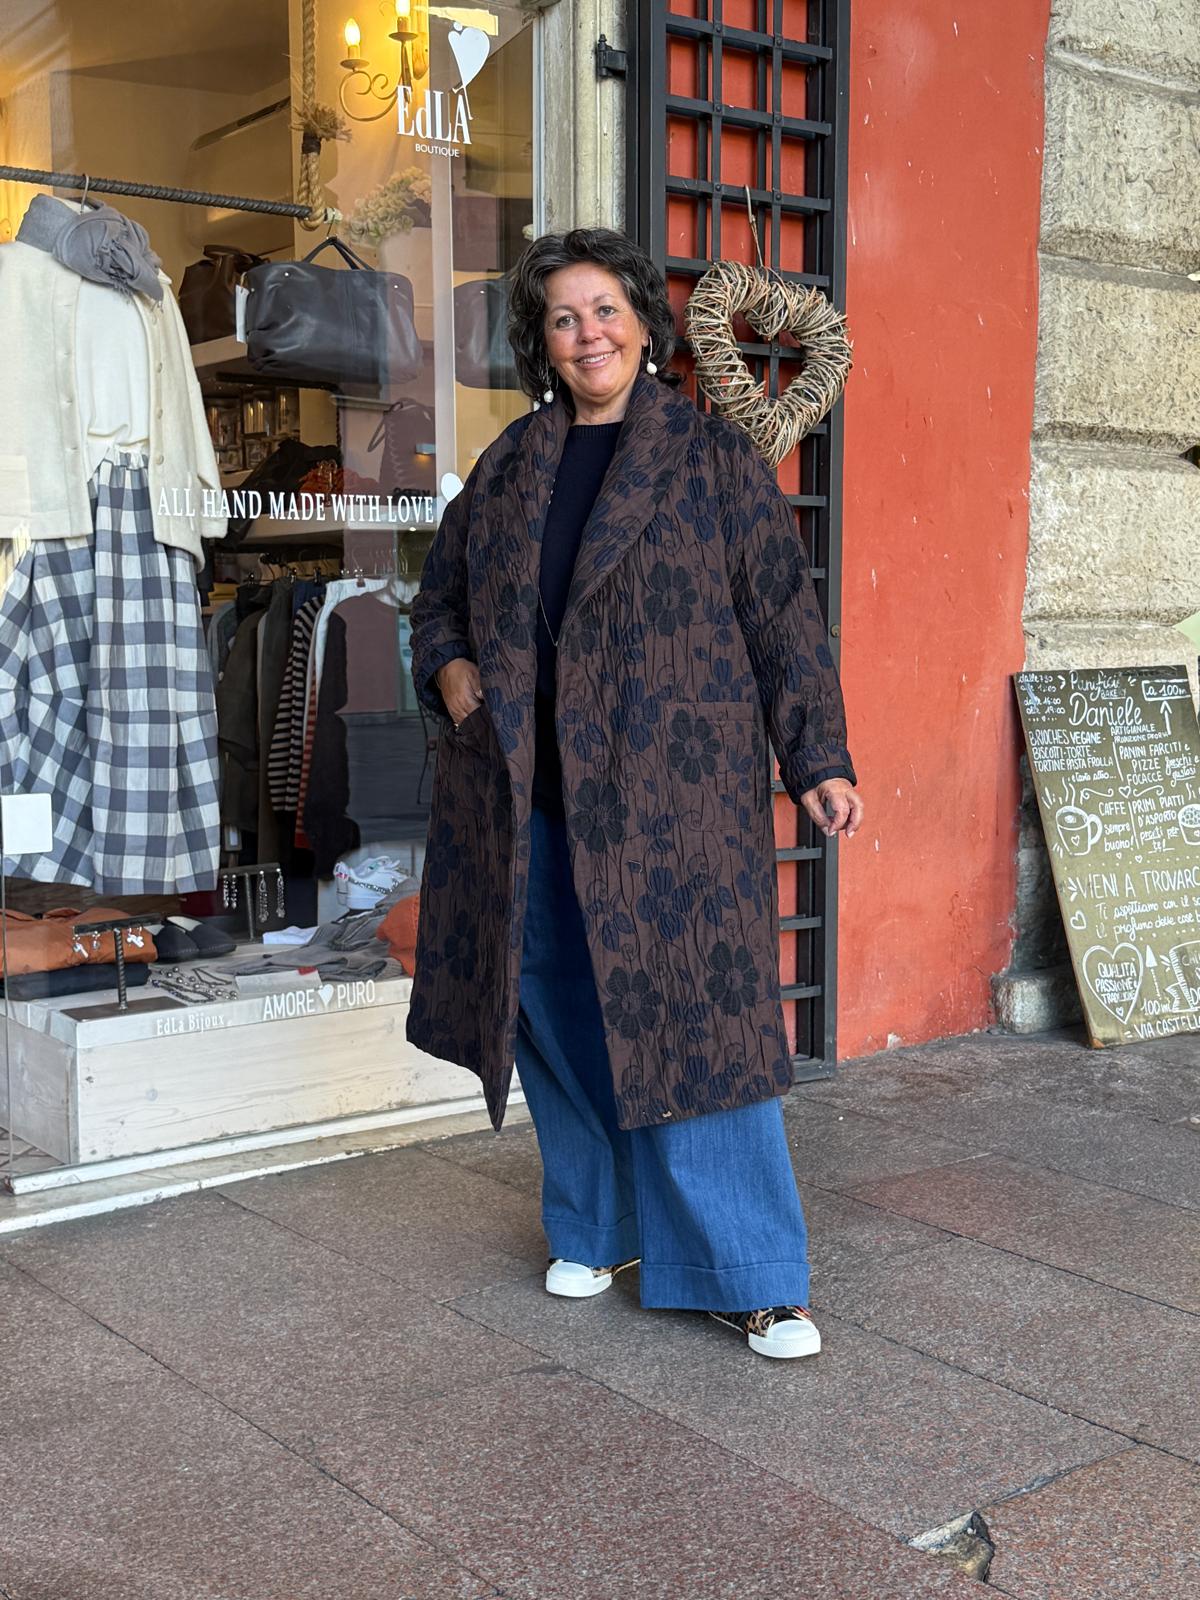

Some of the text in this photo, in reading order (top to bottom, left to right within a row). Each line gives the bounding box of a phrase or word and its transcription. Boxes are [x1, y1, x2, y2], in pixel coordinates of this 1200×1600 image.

[397, 85, 472, 144] EdLA
[415, 144, 460, 157] BOUTIQUE
[157, 487, 434, 523] ALL HAND MADE WITH LOVE
[1146, 686, 1157, 696] a
[1068, 692, 1142, 727] Daniele
[1029, 729, 1102, 746] BRIOCHES VEGANE
[1110, 723, 1156, 737] ARTIGIANALE
[1119, 745, 1146, 760] PANINI
[1149, 740, 1181, 757] FARCITI
[1034, 756, 1114, 773] TORTINE PASTA FROLLA
[1132, 757, 1161, 773] PIZZE
[1127, 771, 1164, 786] FOCACCE
[1132, 794, 1184, 814] PRIMI PIATTI
[1138, 810, 1177, 828] D'ASPORTO
[1104, 822, 1131, 836] sempre
[1076, 873, 1119, 899] VIENI
[1125, 873, 1136, 897] A
[1095, 902, 1108, 920] Ti
[1113, 900, 1158, 920] aspettiamo
[1113, 916, 1153, 943] profumo
[1155, 914, 1176, 928] delle
[1177, 912, 1194, 924] cose
[1098, 957, 1137, 978] QUALITÀ
[1095, 977, 1133, 993] PASSIONE
[264, 980, 376, 1020] AMORE PURO
[156, 1011, 224, 1035] EdLa Bijoux
[1134, 1021, 1156, 1039] VIA
